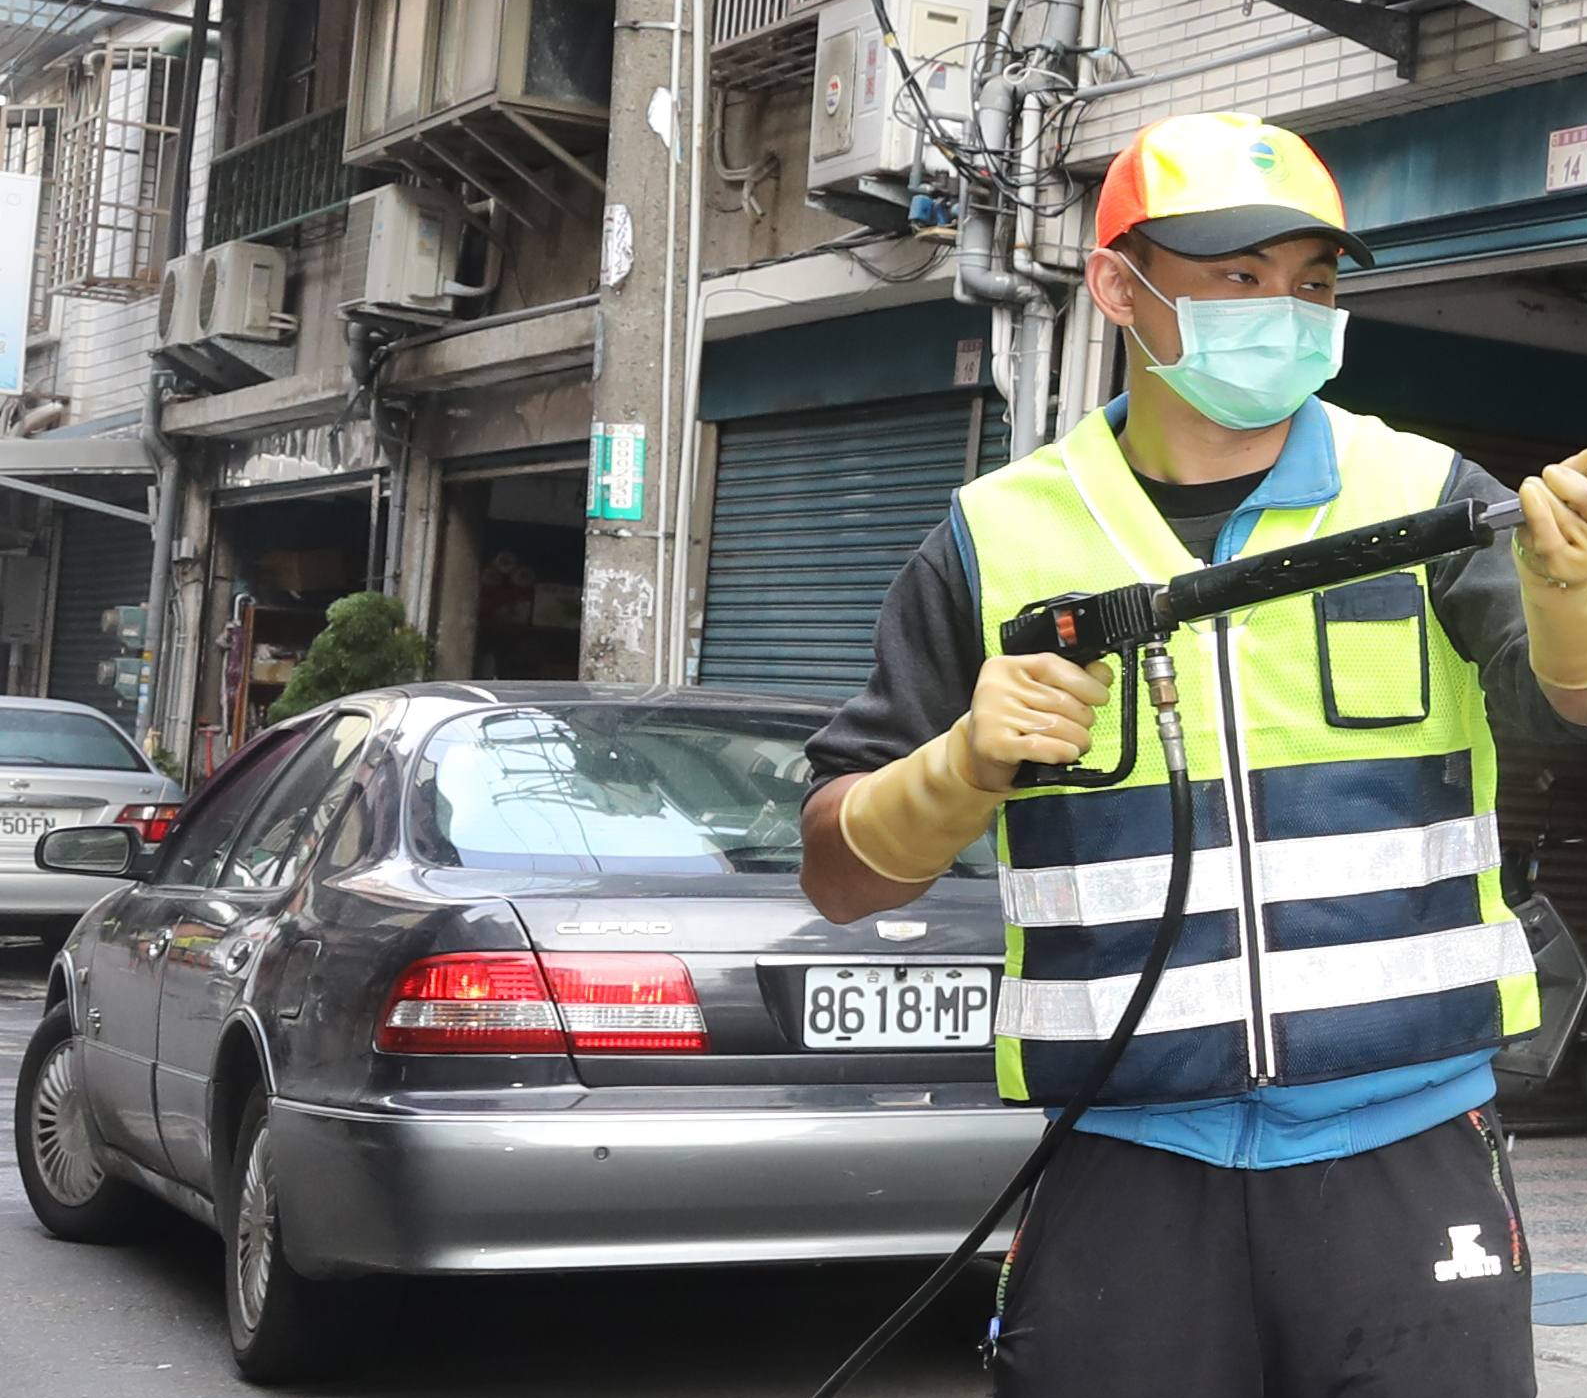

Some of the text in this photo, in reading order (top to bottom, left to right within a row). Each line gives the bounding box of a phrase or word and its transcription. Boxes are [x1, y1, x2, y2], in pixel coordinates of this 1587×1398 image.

[1563, 153, 1582, 183] 14
[0, 816, 56, 835] 50-FN
[865, 969, 935, 984] 台省
